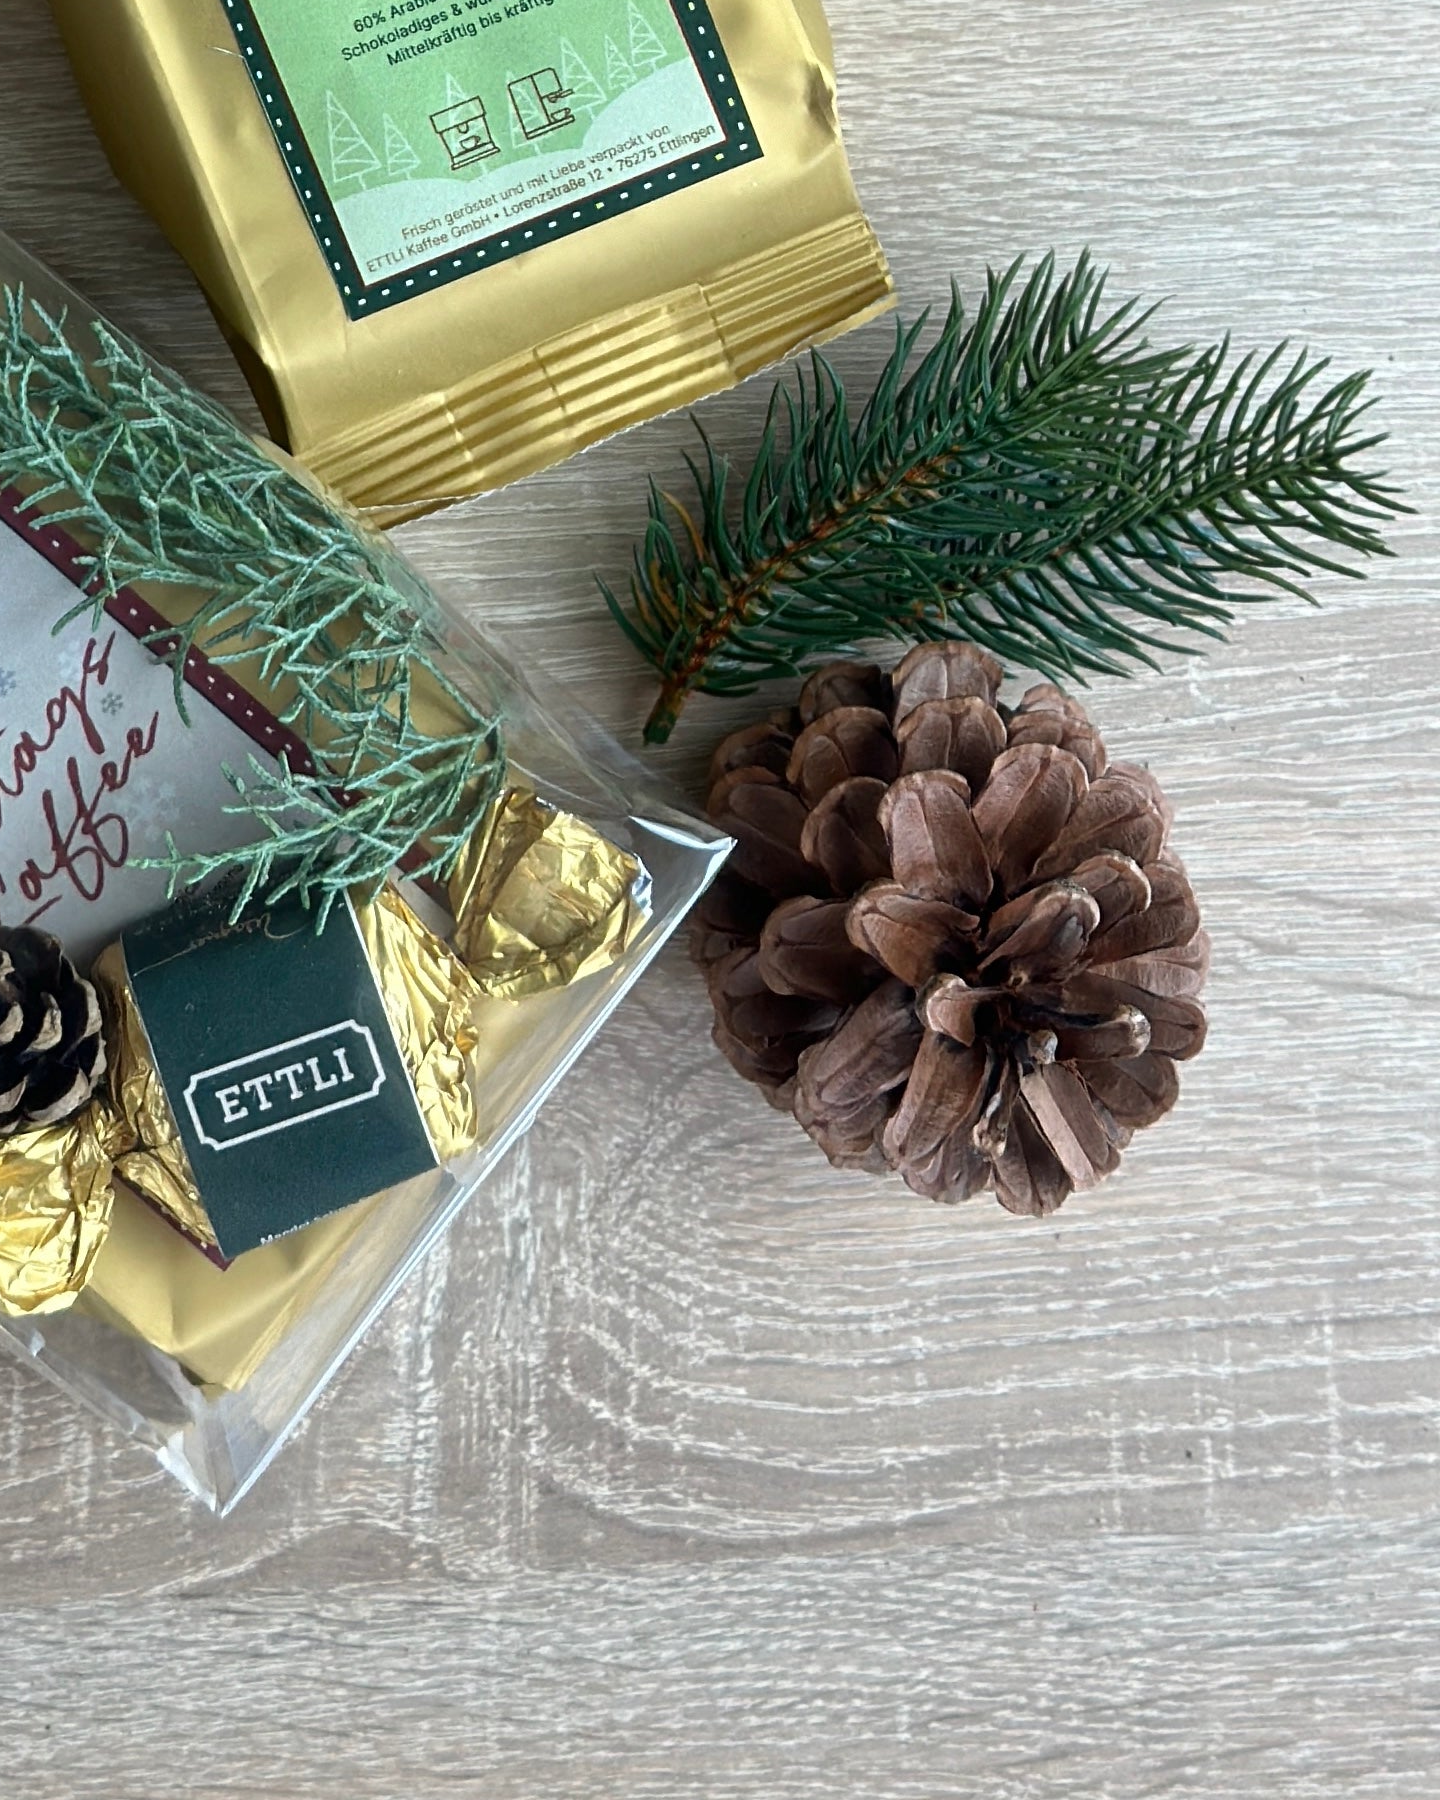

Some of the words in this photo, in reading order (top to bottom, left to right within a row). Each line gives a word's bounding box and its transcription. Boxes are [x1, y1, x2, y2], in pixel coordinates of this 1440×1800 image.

[341, 10, 448, 61] Schokoladiges
[451, 2, 463, 17] &
[353, 10, 386, 33] 60%
[386, 20, 478, 66] Mittelkräftig
[479, 12, 503, 29] bis
[366, 248, 405, 274] ETTLI
[406, 231, 450, 257] Kaffee
[449, 213, 492, 239] GmbH
[502, 176, 587, 219] Lorenzstraße
[588, 167, 605, 183] 12
[615, 148, 658, 172] 76275
[658, 125, 717, 157] Ettlingen
[401, 215, 443, 241] Frisch
[444, 194, 499, 226] geröstet
[498, 182, 525, 206] und
[526, 172, 549, 194] mit
[549, 157, 588, 182] Liebe
[588, 133, 645, 169] verpackt
[645, 124, 671, 142] von
[215, 1047, 355, 1124] ETTLI
